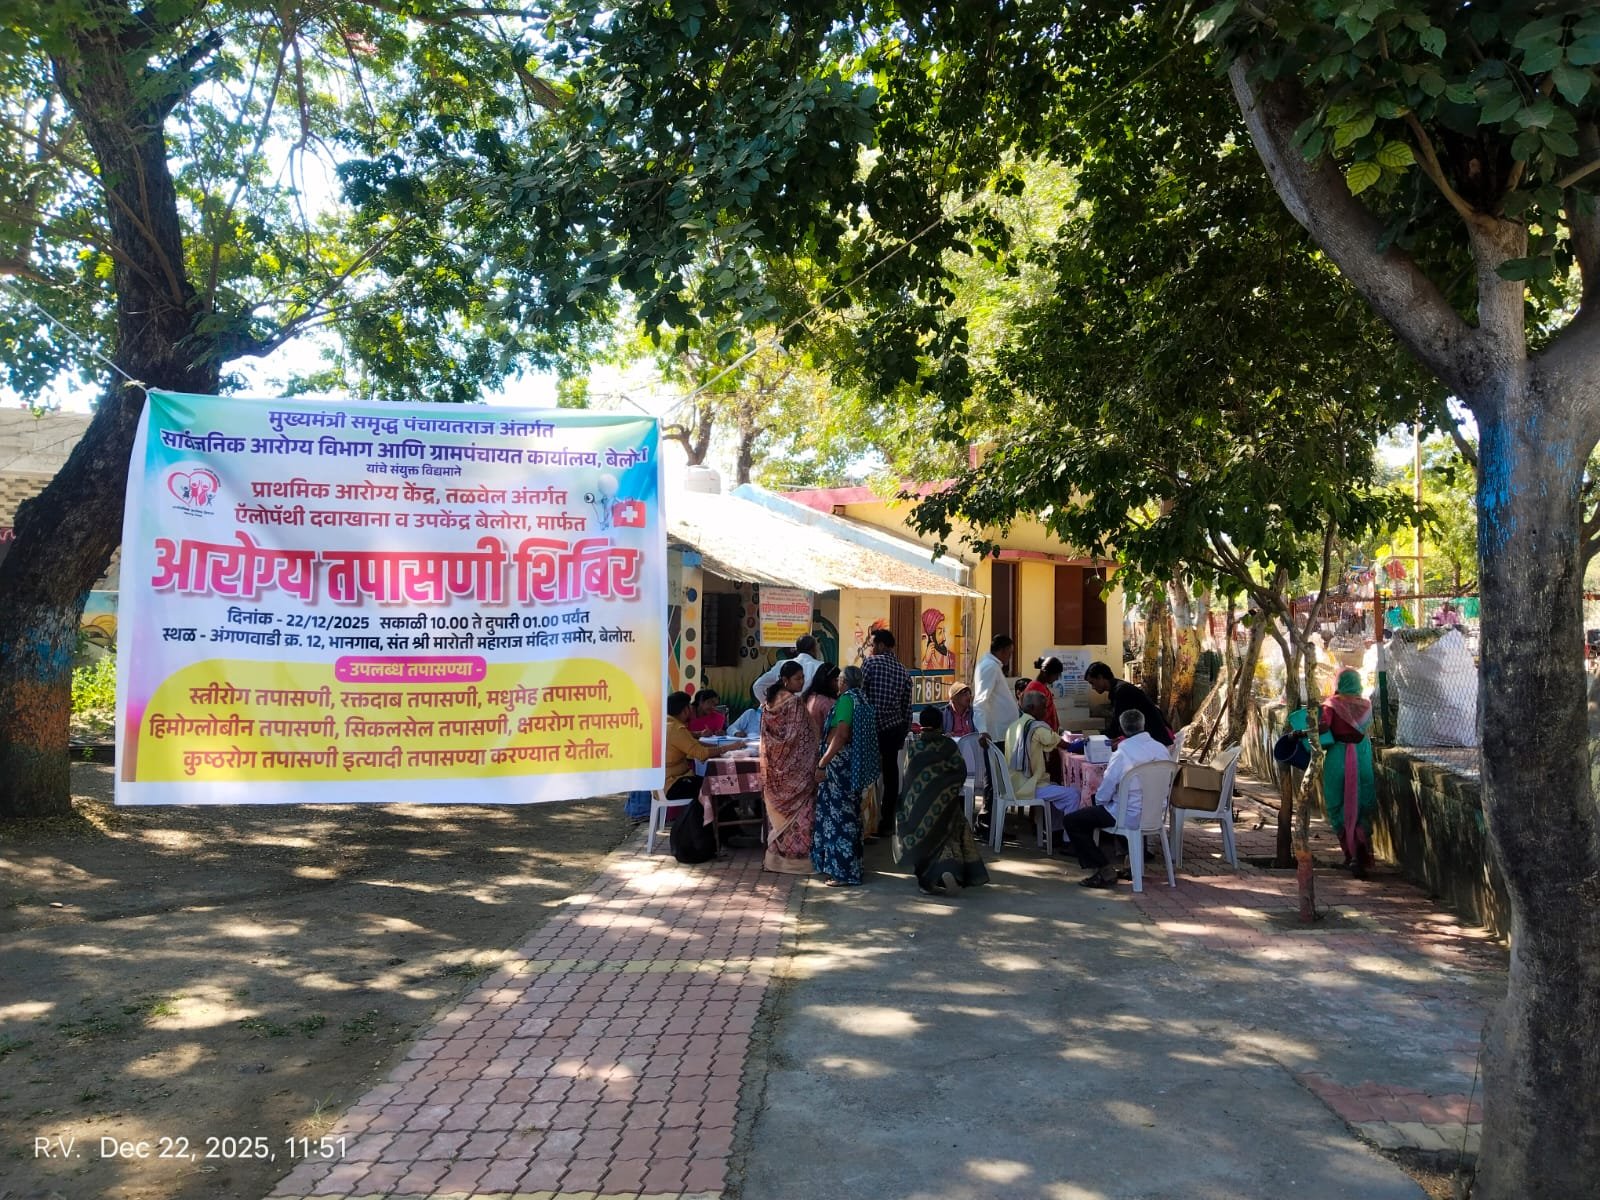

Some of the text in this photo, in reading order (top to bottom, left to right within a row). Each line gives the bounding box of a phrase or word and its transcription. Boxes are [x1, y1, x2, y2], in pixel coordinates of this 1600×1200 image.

[269, 411, 555, 438] मुख्यमंत्री समृद्ध पंचायतराज अंतर्गत
[251, 434, 314, 456] आरोग्य
[318, 436, 373, 458] विभाग
[378, 439, 426, 460] आणि
[430, 443, 523, 464] ग्रामपंचायत
[528, 447, 602, 468] कार्यालय,
[366, 464, 462, 478] यांचे संयुक्त विद्यमाने
[251, 478, 568, 505] प्राथमिक आरोग्य केंद्र, तळवेल अंतर्गत
[309, 510, 390, 528] दवाखाना
[395, 513, 408, 528] व
[413, 508, 472, 530] उपकेंद्र
[476, 510, 532, 532] बेलोरा,
[536, 512, 587, 532] मार्फत
[151, 531, 640, 602] आरोग्य तपासणी शिबिर
[227, 606, 274, 625] दिनांक
[286, 614, 369, 630] 22/12/2025
[380, 613, 427, 630] सकाळी
[431, 616, 468, 630] 10.00
[472, 612, 483, 630] ते
[485, 613, 520, 635] दुपारी
[523, 614, 558, 630] 01.00
[162, 627, 197, 642] स्थळ
[209, 626, 282, 647] अंगणवाडी
[284, 632, 302, 647] क्र.
[306, 635, 325, 650] 12,
[329, 635, 384, 651] भानगाव,
[387, 631, 409, 649] संत
[412, 631, 430, 650] श्री
[433, 632, 474, 650] मारोती
[477, 634, 523, 650] महाराज
[526, 631, 559, 648] मंदिरा
[562, 627, 597, 644] समोर,
[599, 626, 636, 644] बेलोरा.
[350, 662, 406, 676] उपलब्ध
[408, 662, 473, 677] तपासण्या
[189, 679, 612, 712] स्त्रीरोग तपासणी, रक्तदाब तपासणी, मधुमेह तपासणी,
[916, 681, 941, 701] 7 8 9
[149, 707, 643, 740] हिमोग्लोबीन तपासणी, सिकलसेल तपासणी, क्षयरोग तपासणी,
[184, 738, 613, 776] कुष्ठरोग तपासणी इत्यादी तपासण्या करण्यात येतील.
